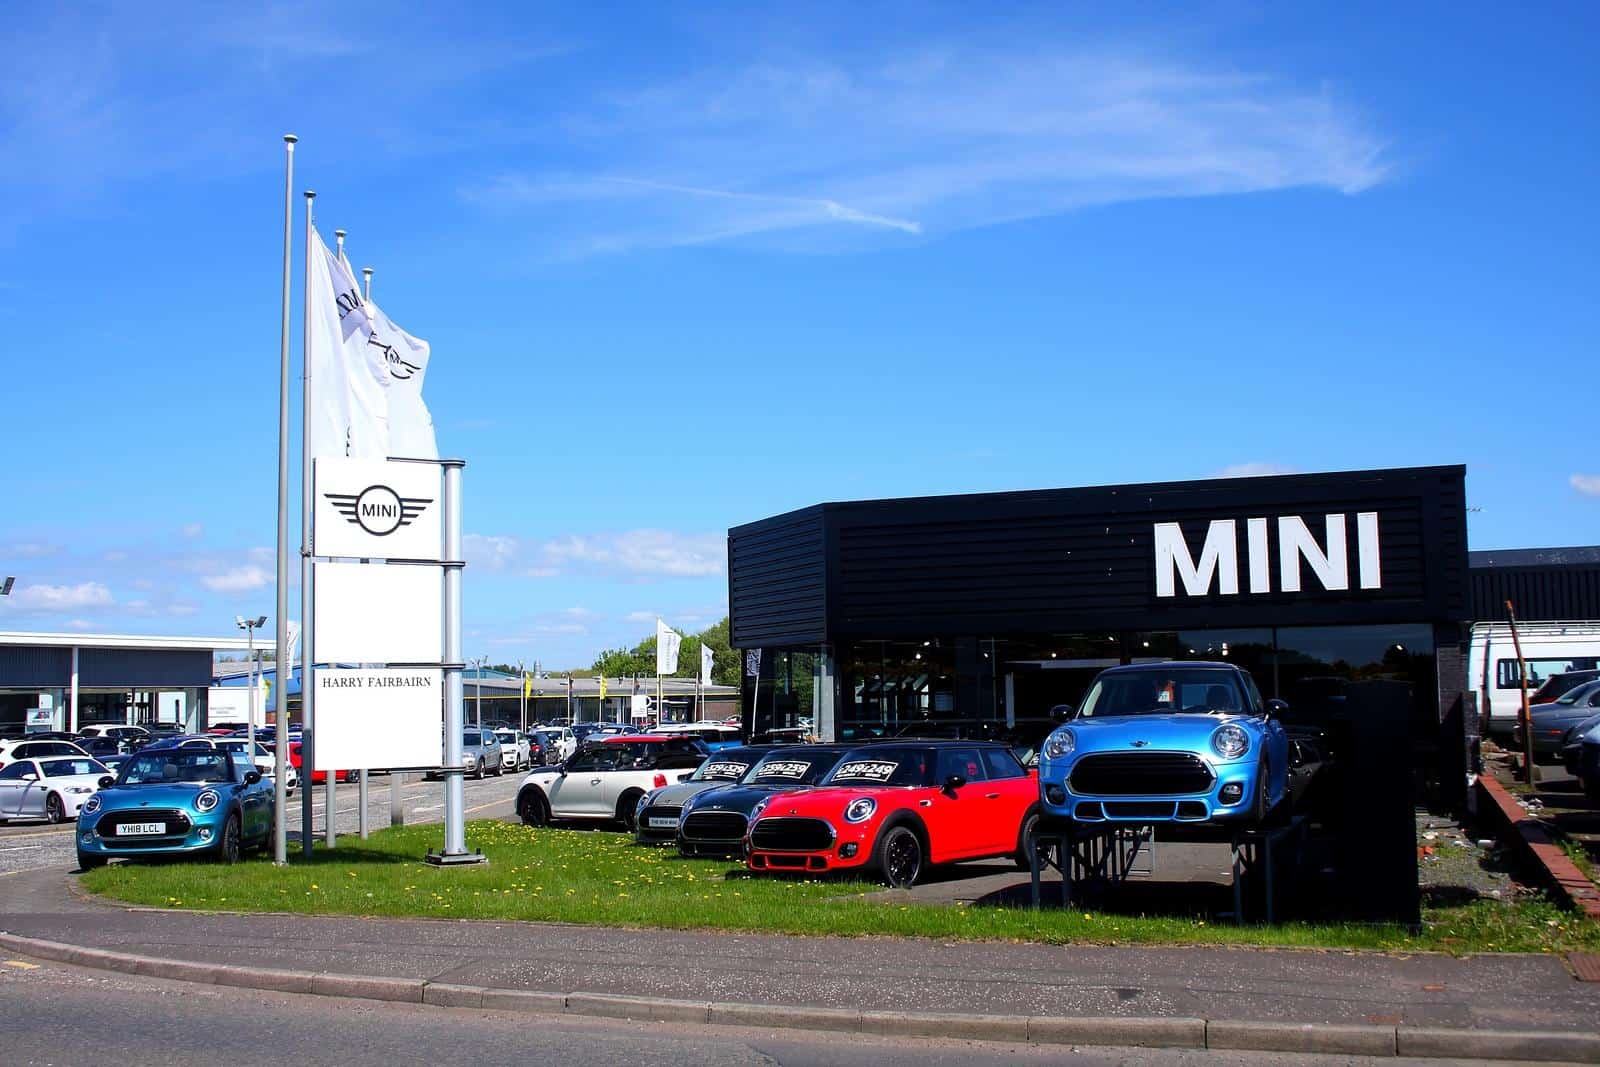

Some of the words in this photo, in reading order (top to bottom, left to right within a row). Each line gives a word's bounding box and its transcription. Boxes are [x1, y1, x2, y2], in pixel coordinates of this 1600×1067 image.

[362, 503, 396, 518] MINI
[1153, 511, 1382, 597] MINI
[322, 677, 363, 688] HARRY
[368, 676, 432, 688] FAIRBAIRN
[143, 823, 160, 833] LCL
